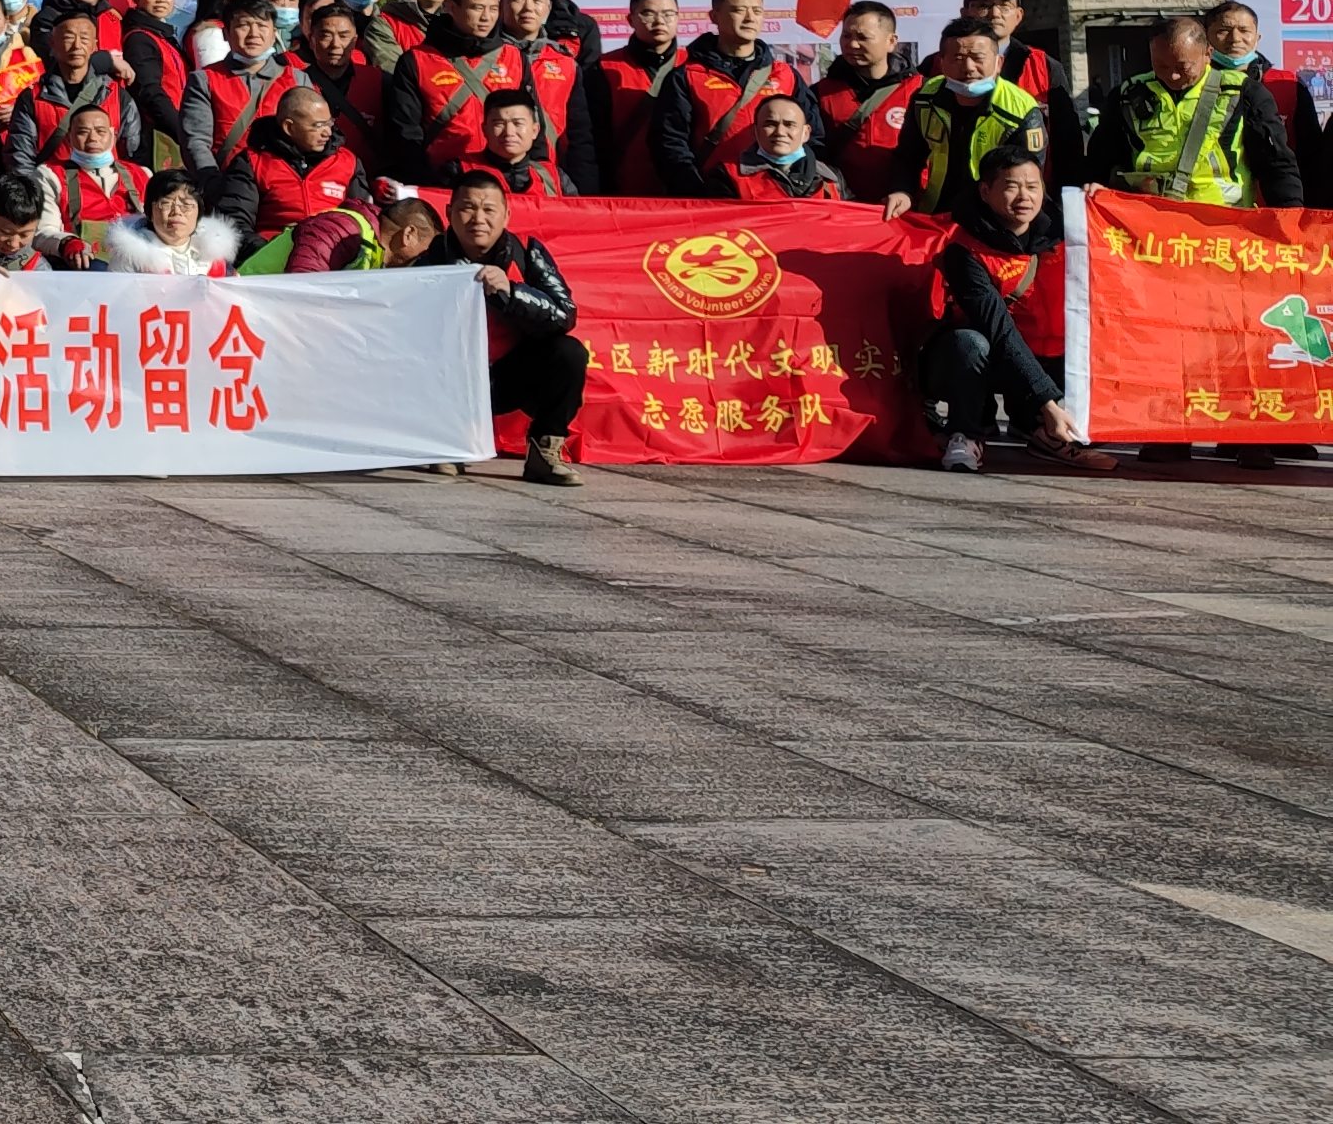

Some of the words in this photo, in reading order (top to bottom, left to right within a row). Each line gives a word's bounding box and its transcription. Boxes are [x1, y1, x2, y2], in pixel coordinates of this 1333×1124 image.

[1103, 225, 1333, 276] 黄山市退役军人
[656, 272, 685, 299] China
[686, 293, 745, 312] Volunteer
[640, 392, 832, 434] 志愿服务队
